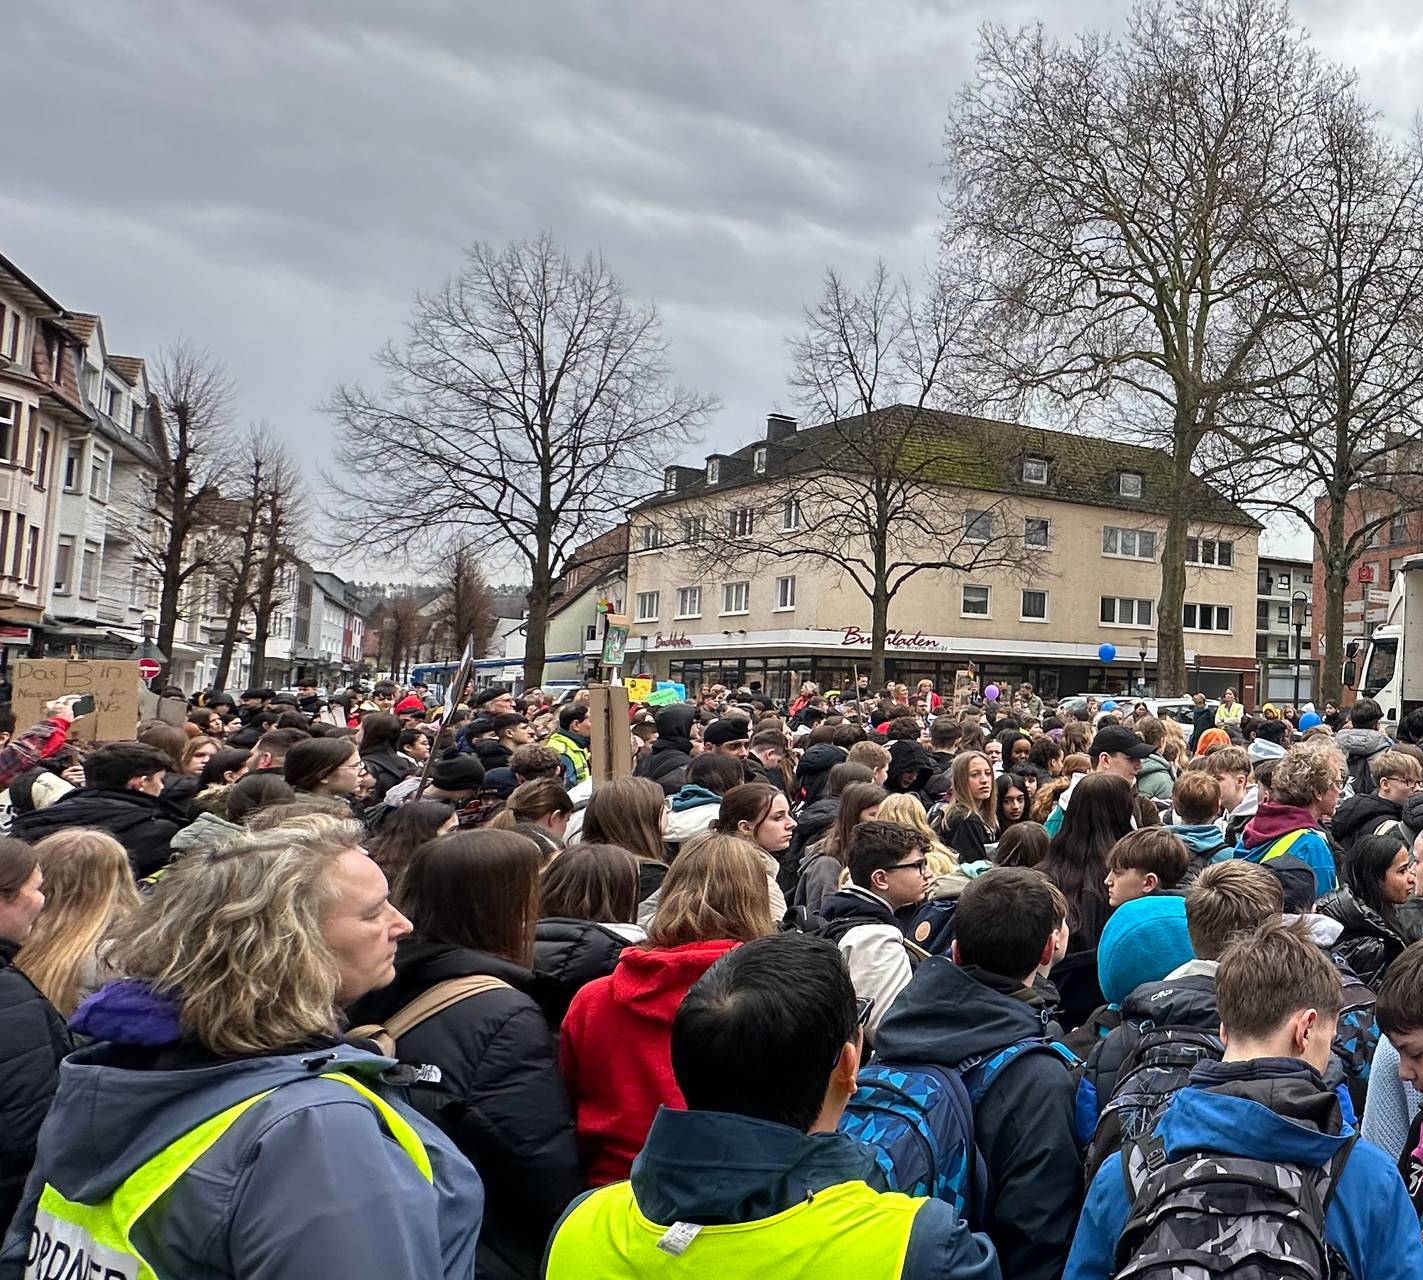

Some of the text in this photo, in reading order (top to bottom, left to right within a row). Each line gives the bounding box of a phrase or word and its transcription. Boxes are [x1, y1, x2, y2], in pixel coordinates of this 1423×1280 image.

[841, 626, 939, 646] Buhladen
[18, 662, 57, 680] Das
[63, 661, 93, 688] B
